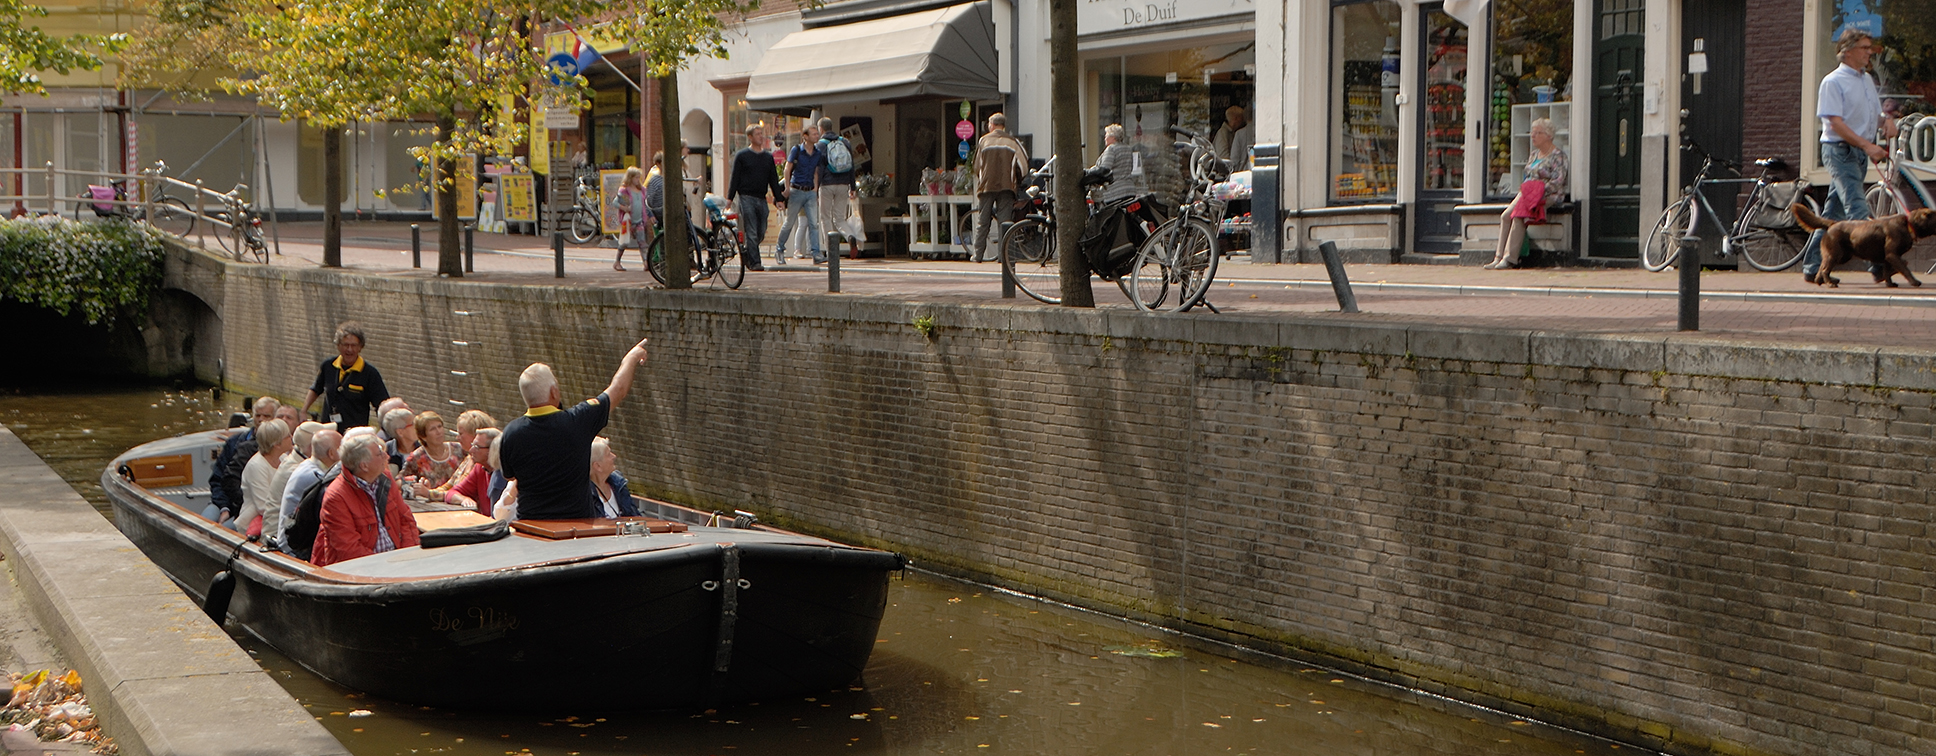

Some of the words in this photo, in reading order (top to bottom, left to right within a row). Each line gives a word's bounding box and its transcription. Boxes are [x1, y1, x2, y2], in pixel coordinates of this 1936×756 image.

[1123, 8, 1142, 25] De
[1146, 1, 1177, 22] Duif
[429, 607, 464, 631] De
